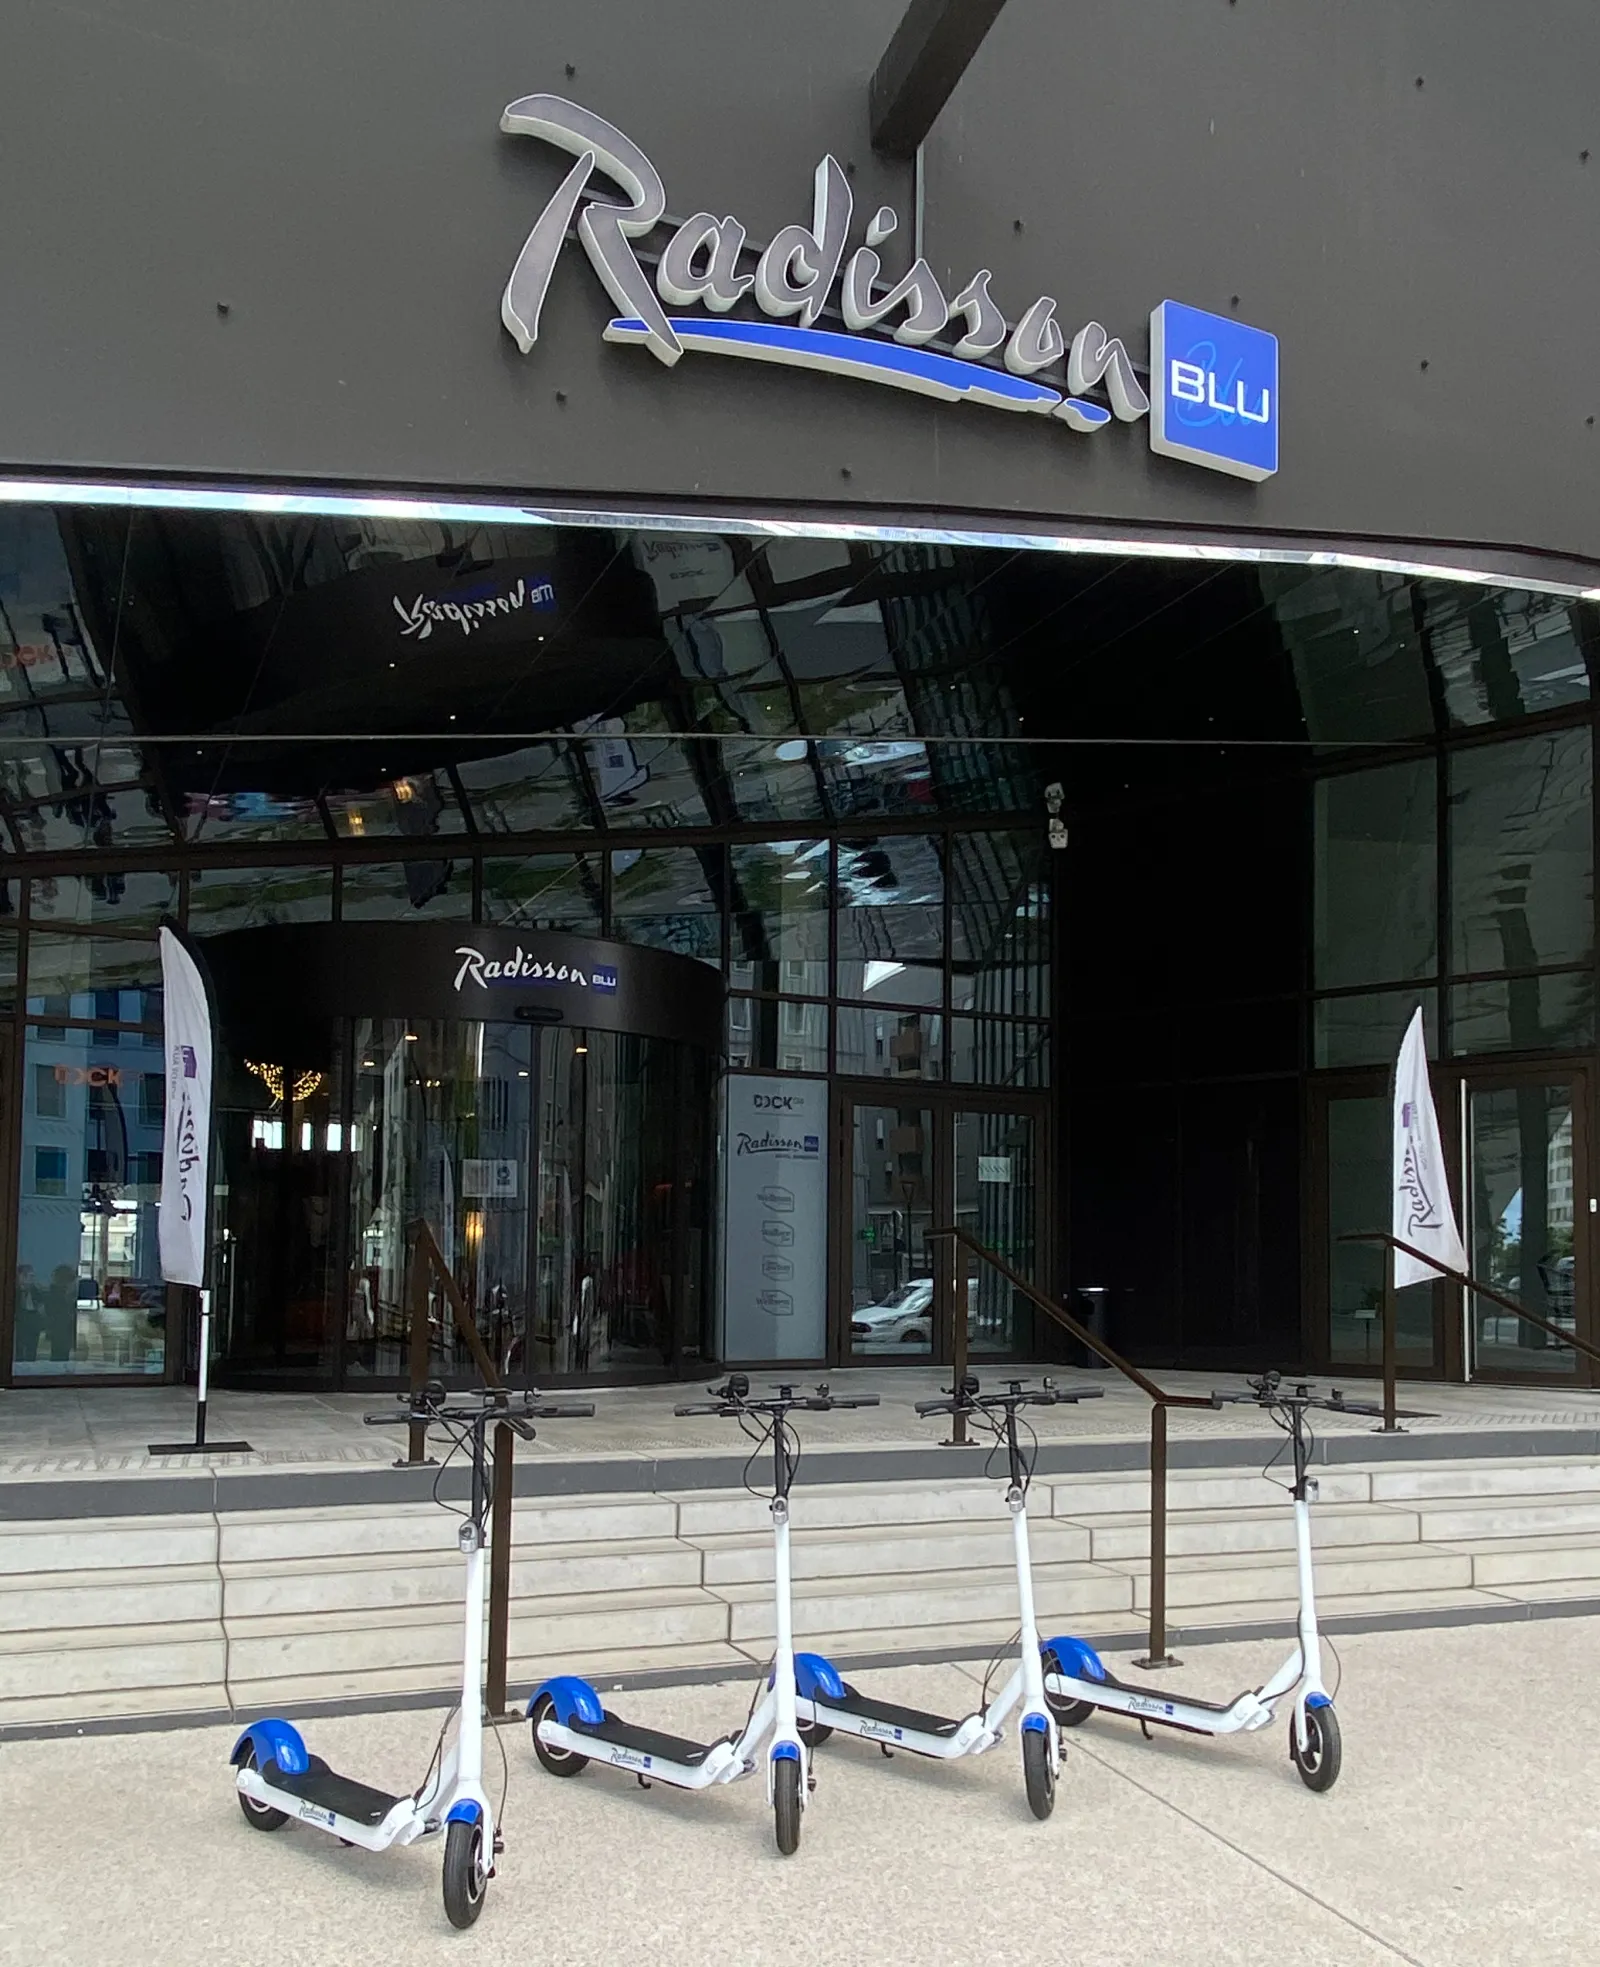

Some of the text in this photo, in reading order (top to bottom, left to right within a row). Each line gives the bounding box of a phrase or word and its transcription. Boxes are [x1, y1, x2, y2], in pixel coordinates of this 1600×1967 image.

[500, 93, 1269, 424] Radisson BLU
[453, 945, 616, 992] Radisson BLU
[736, 1130, 803, 1157] Radisson
